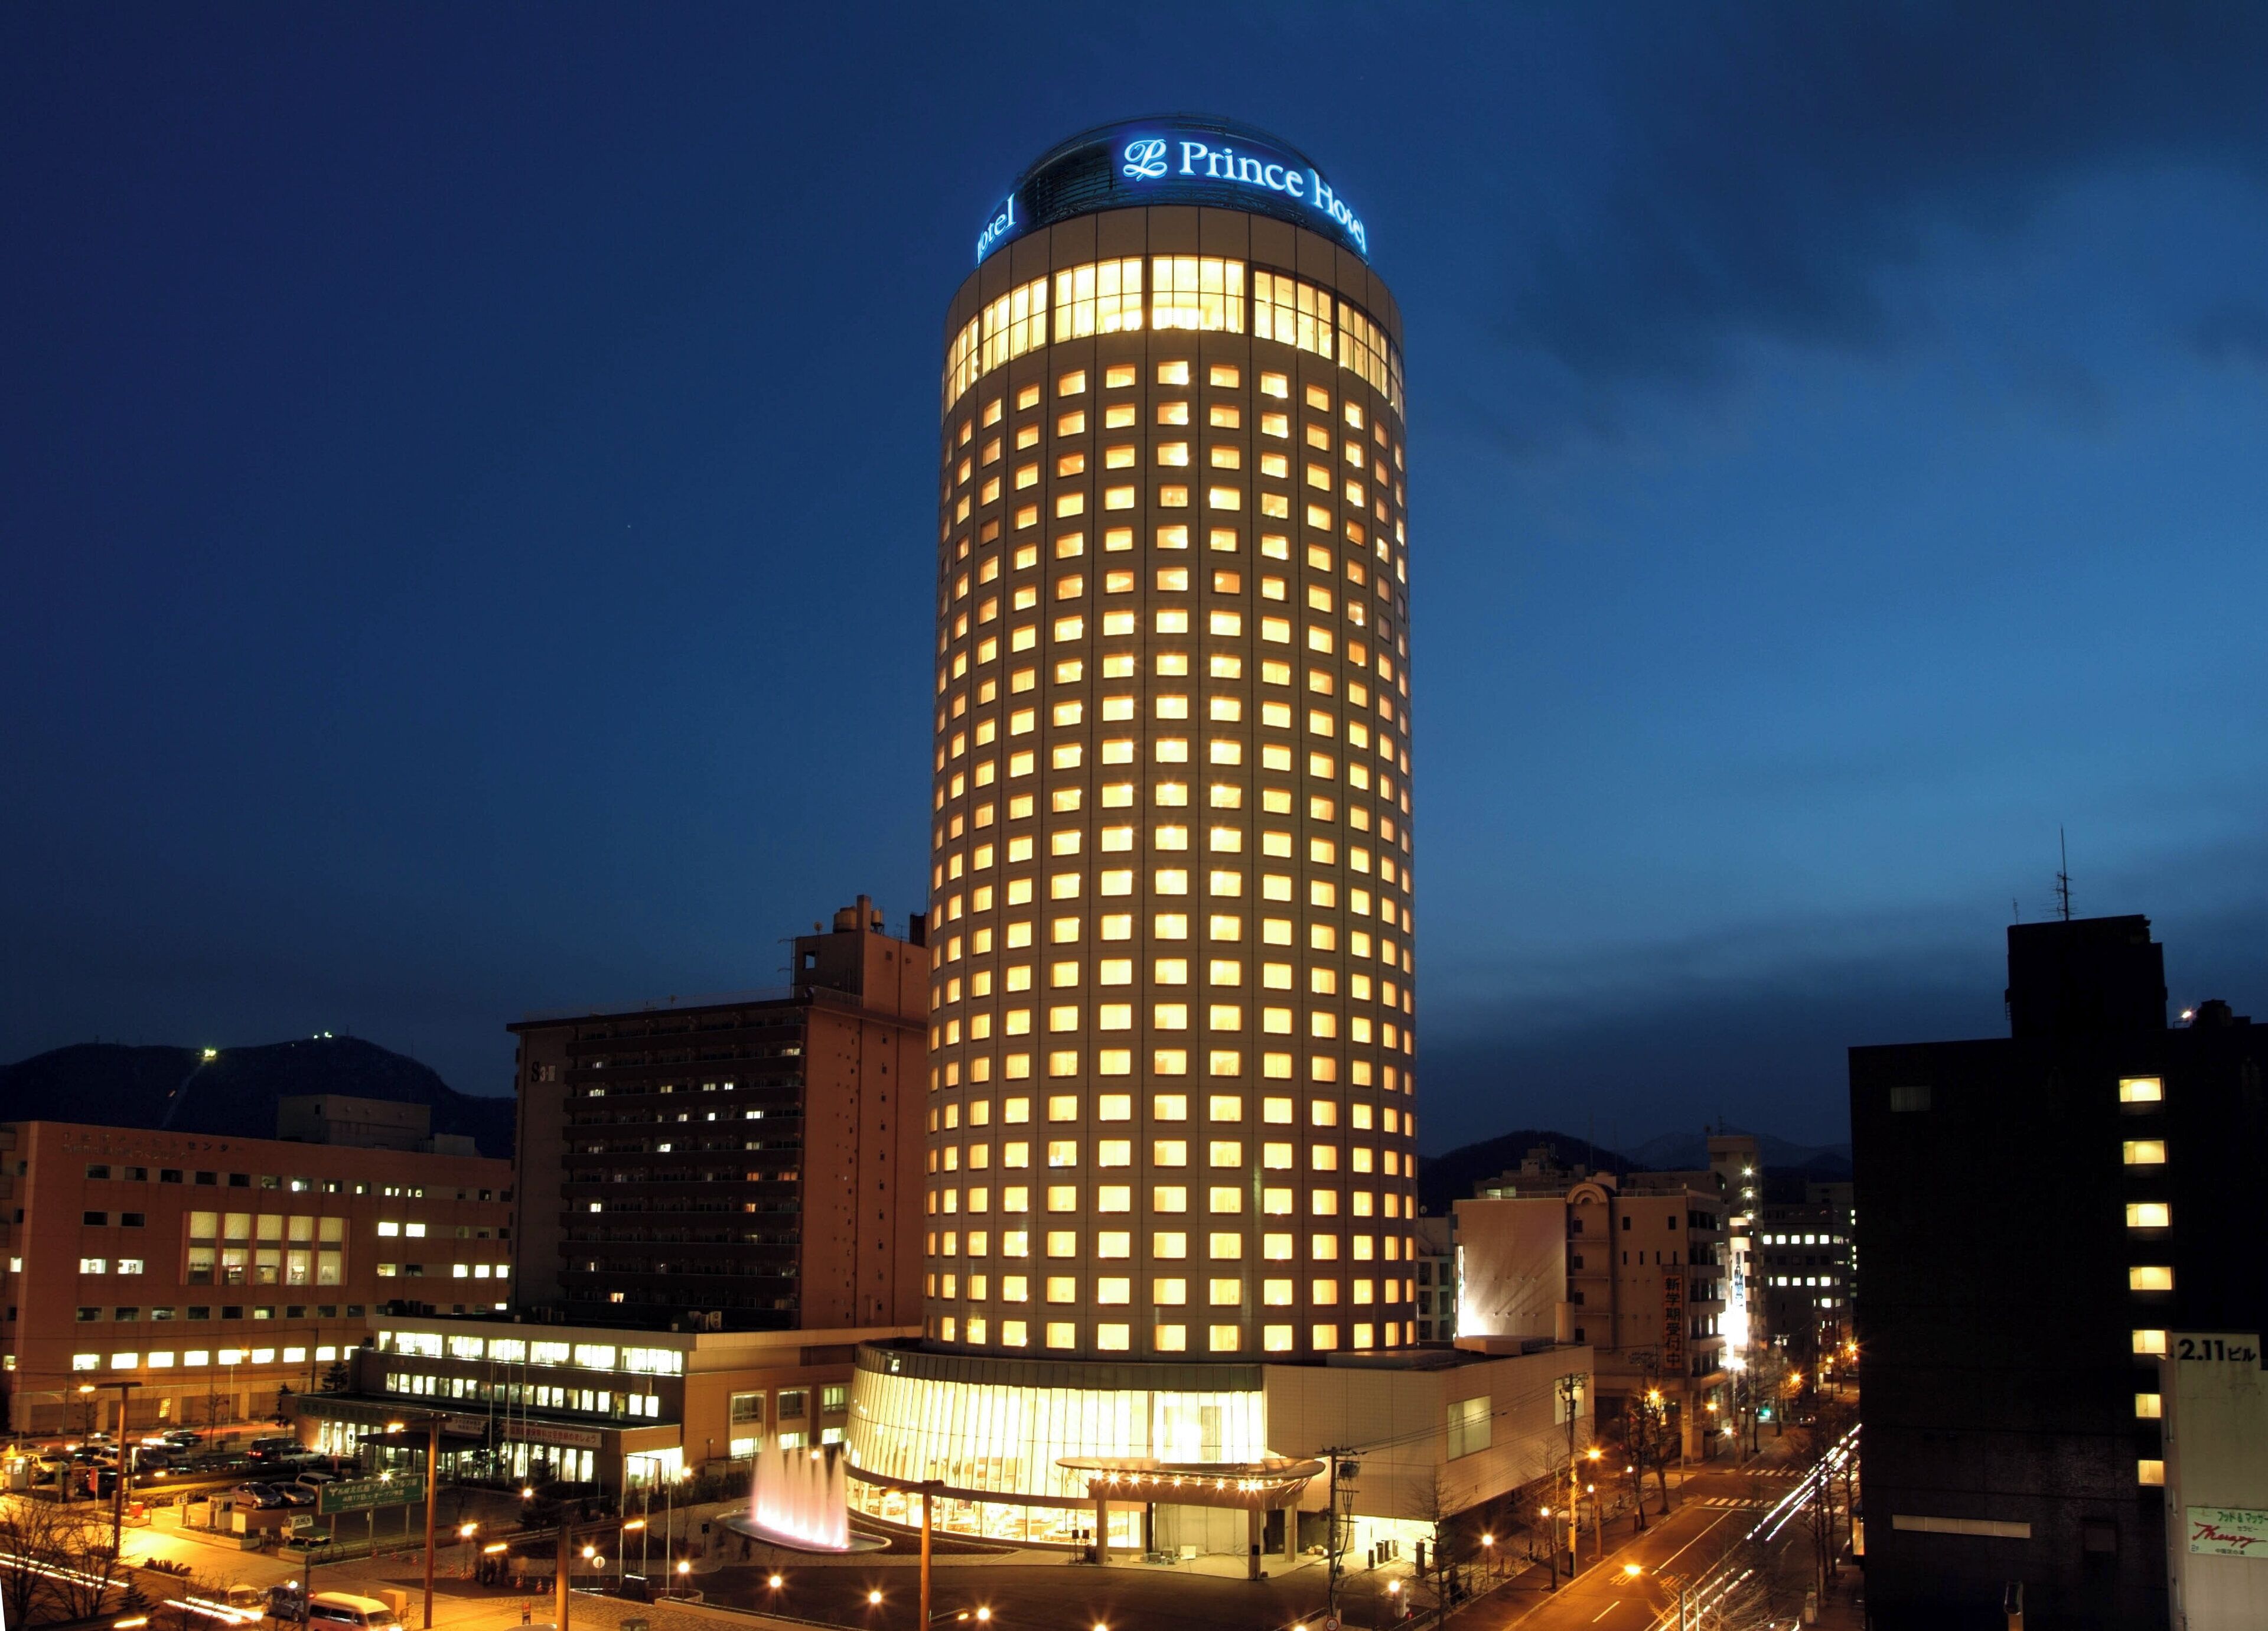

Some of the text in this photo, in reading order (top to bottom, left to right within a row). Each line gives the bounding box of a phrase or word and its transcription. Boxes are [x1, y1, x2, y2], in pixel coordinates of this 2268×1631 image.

[1179, 141, 1304, 197] Prince
[1308, 168, 1367, 255] Hotel
[1665, 1277, 1681, 1366] 新学期受付中
